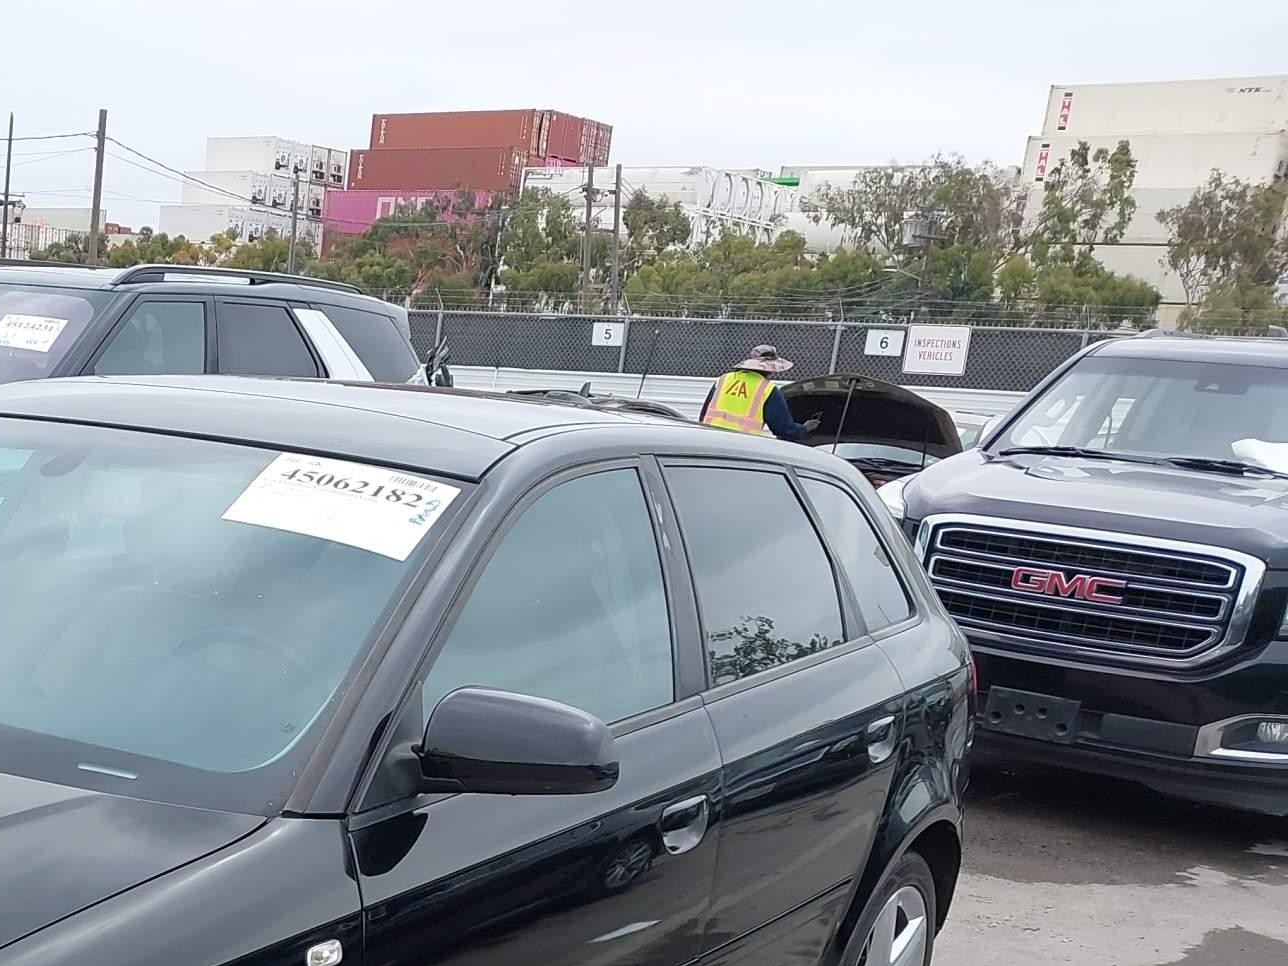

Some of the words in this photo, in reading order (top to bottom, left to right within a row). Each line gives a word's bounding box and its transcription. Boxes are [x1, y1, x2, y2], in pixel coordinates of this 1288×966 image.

[603, 328, 612, 341] 5
[879, 336, 889, 349] 6
[914, 338, 961, 350] INSPECTIONS
[918, 351, 953, 361] VEHICLES
[281, 468, 423, 508] 45062182
[1011, 566, 1128, 605] GMC
